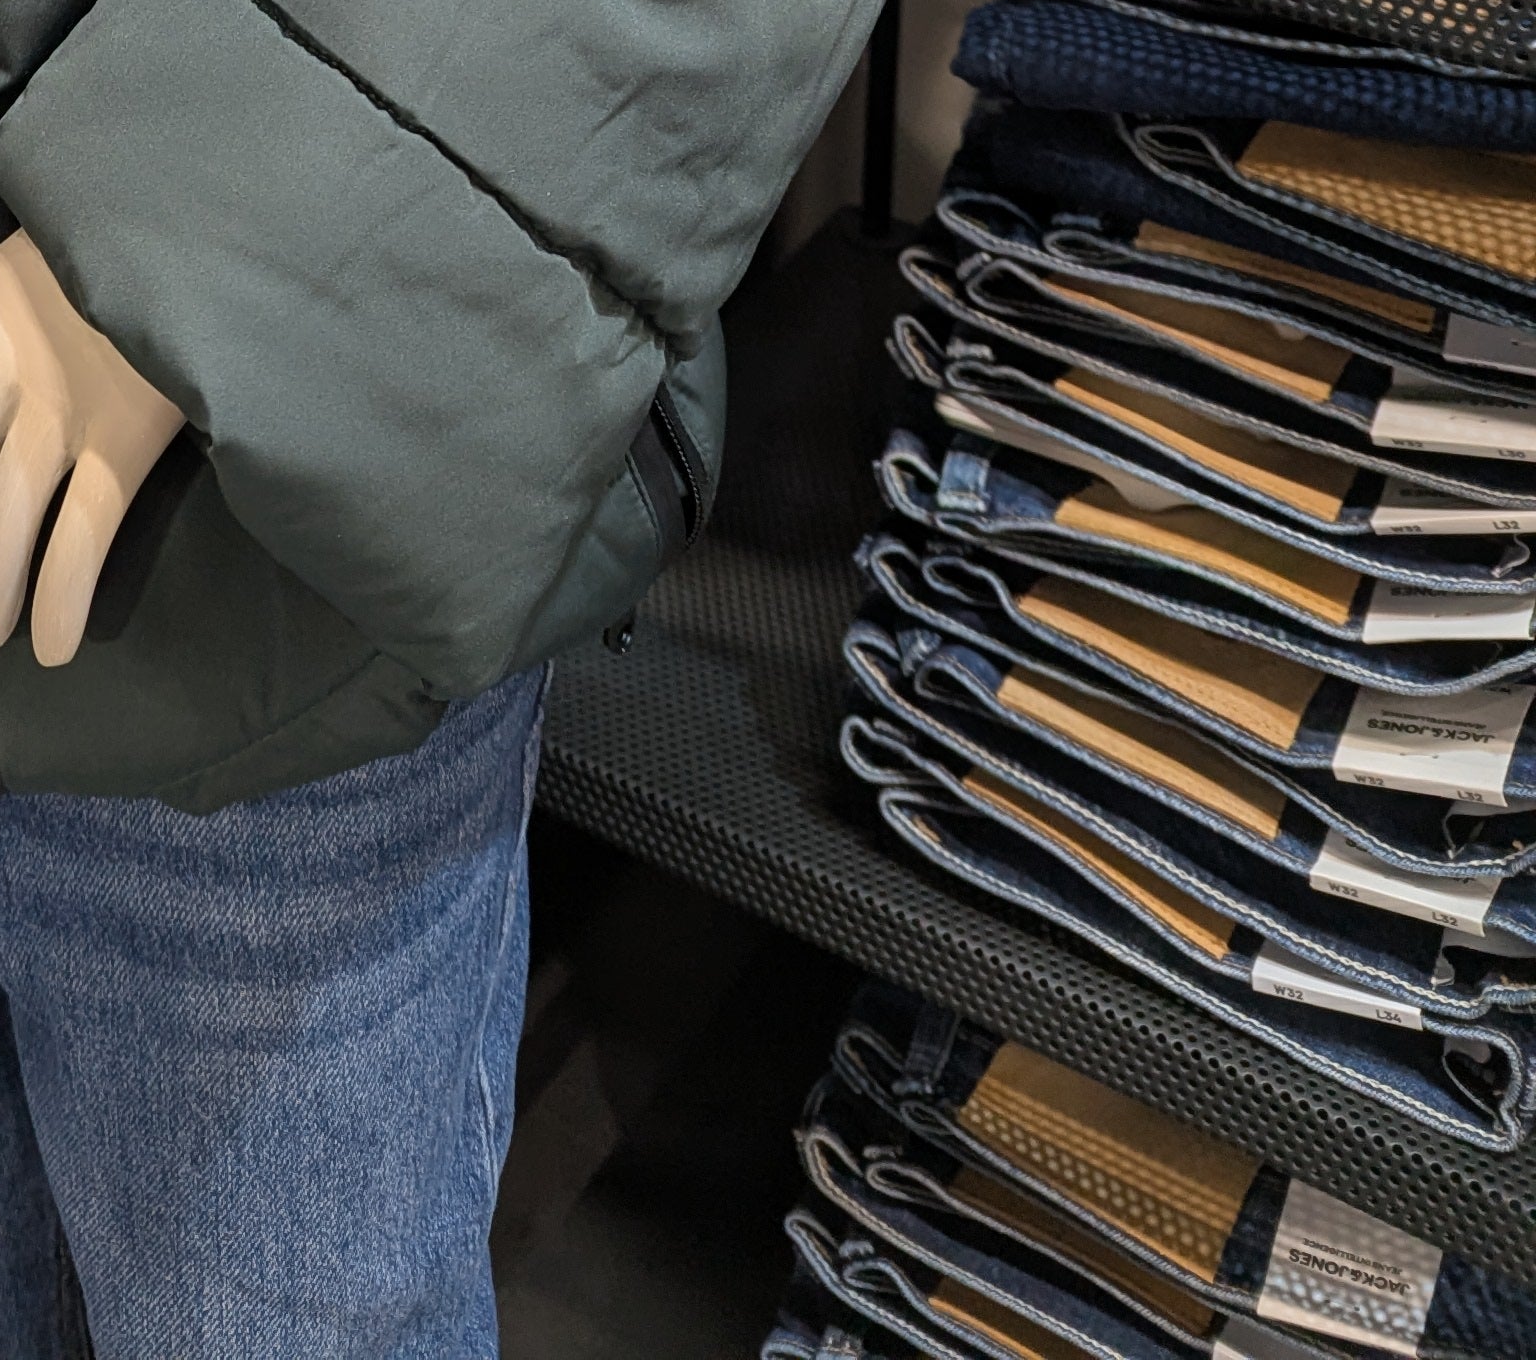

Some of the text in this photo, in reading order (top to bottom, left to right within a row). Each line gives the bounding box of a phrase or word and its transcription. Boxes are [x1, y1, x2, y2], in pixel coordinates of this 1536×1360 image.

[1492, 520, 1521, 530] L32
[1457, 790, 1484, 802] L32
[1328, 882, 1458, 927] W32 L32
[1273, 983, 1402, 1023] W32 L34
